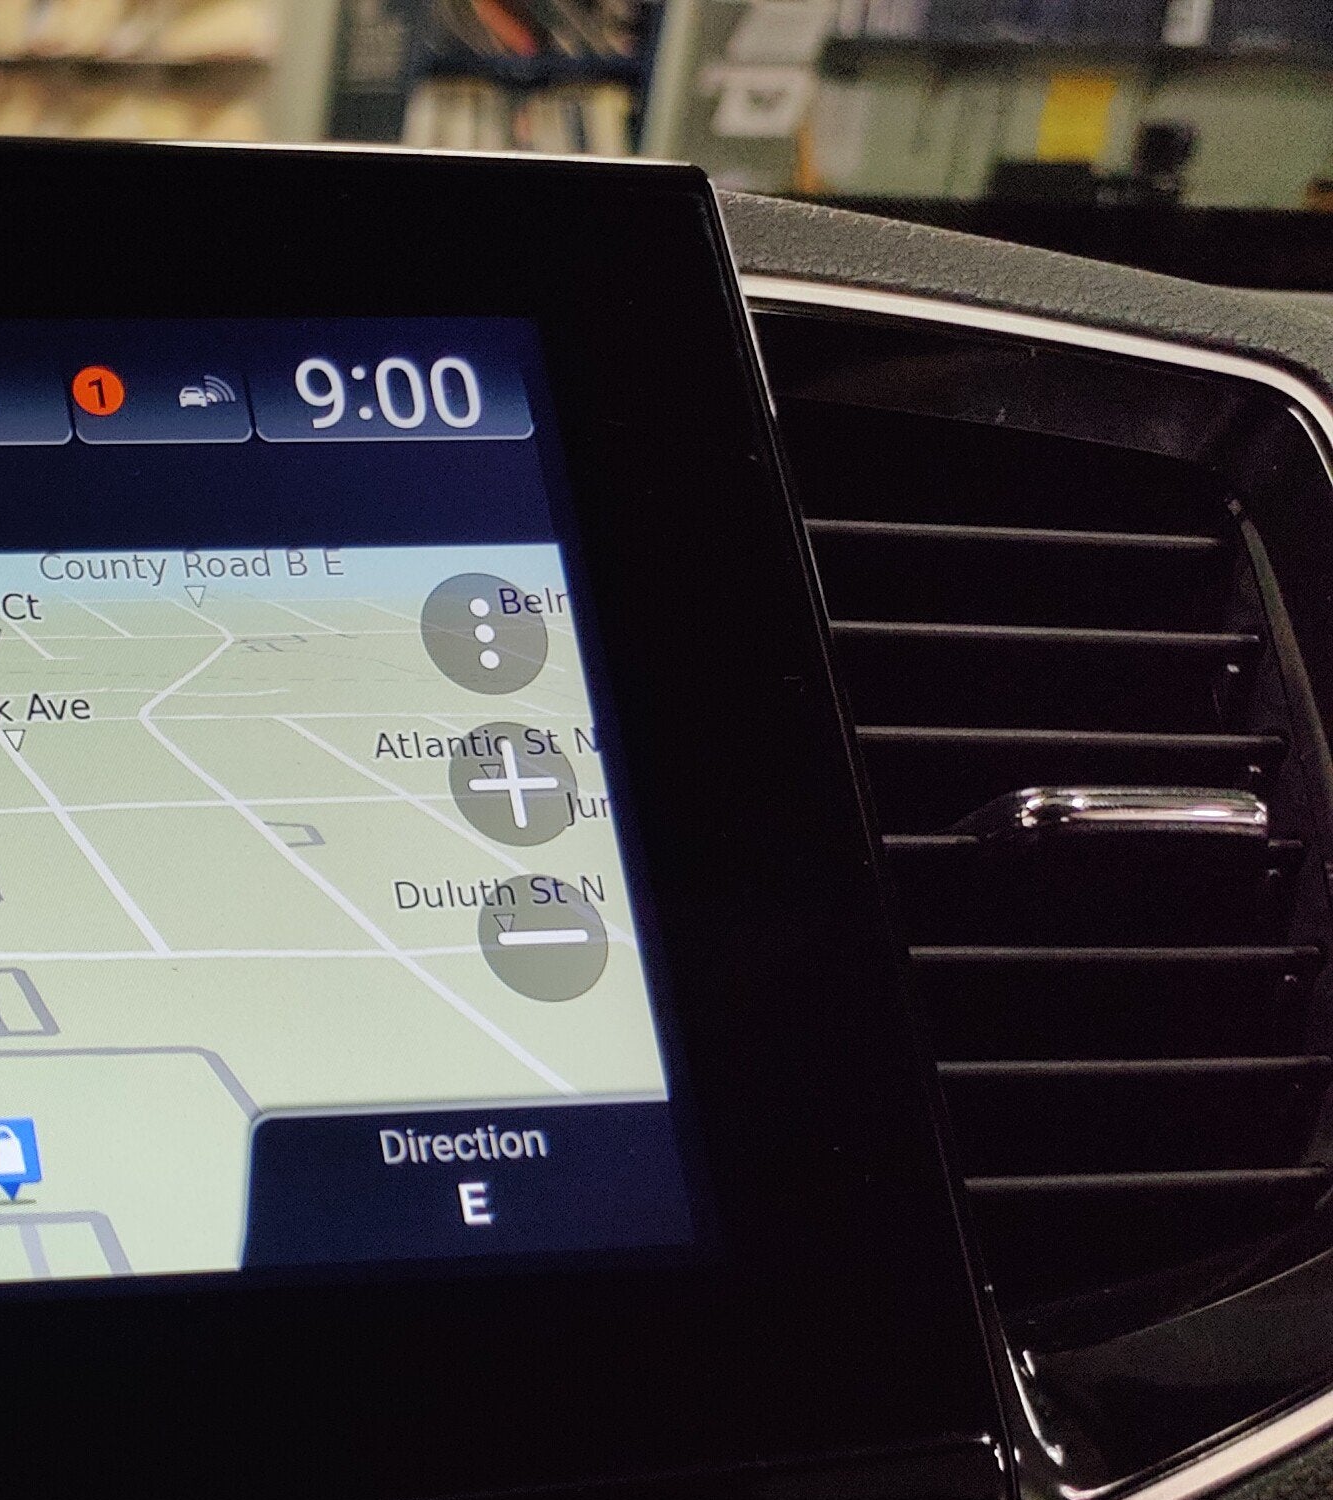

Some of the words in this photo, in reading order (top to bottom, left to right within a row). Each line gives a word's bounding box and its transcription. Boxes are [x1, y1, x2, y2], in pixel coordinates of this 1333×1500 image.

[88, 376, 106, 409] 1
[294, 356, 481, 430] 9:00
[38, 551, 168, 587] County
[183, 548, 271, 578] Road
[285, 549, 309, 577] B
[322, 548, 345, 576] E
[0, 592, 42, 621] Ct
[26, 693, 92, 721] Ave
[374, 729, 510, 760] Atlantic
[523, 727, 563, 756] St
[393, 878, 517, 910] Duluth
[529, 876, 569, 906] St
[579, 874, 607, 904] N
[379, 1124, 548, 1165] Direction
[458, 1181, 493, 1225] E
